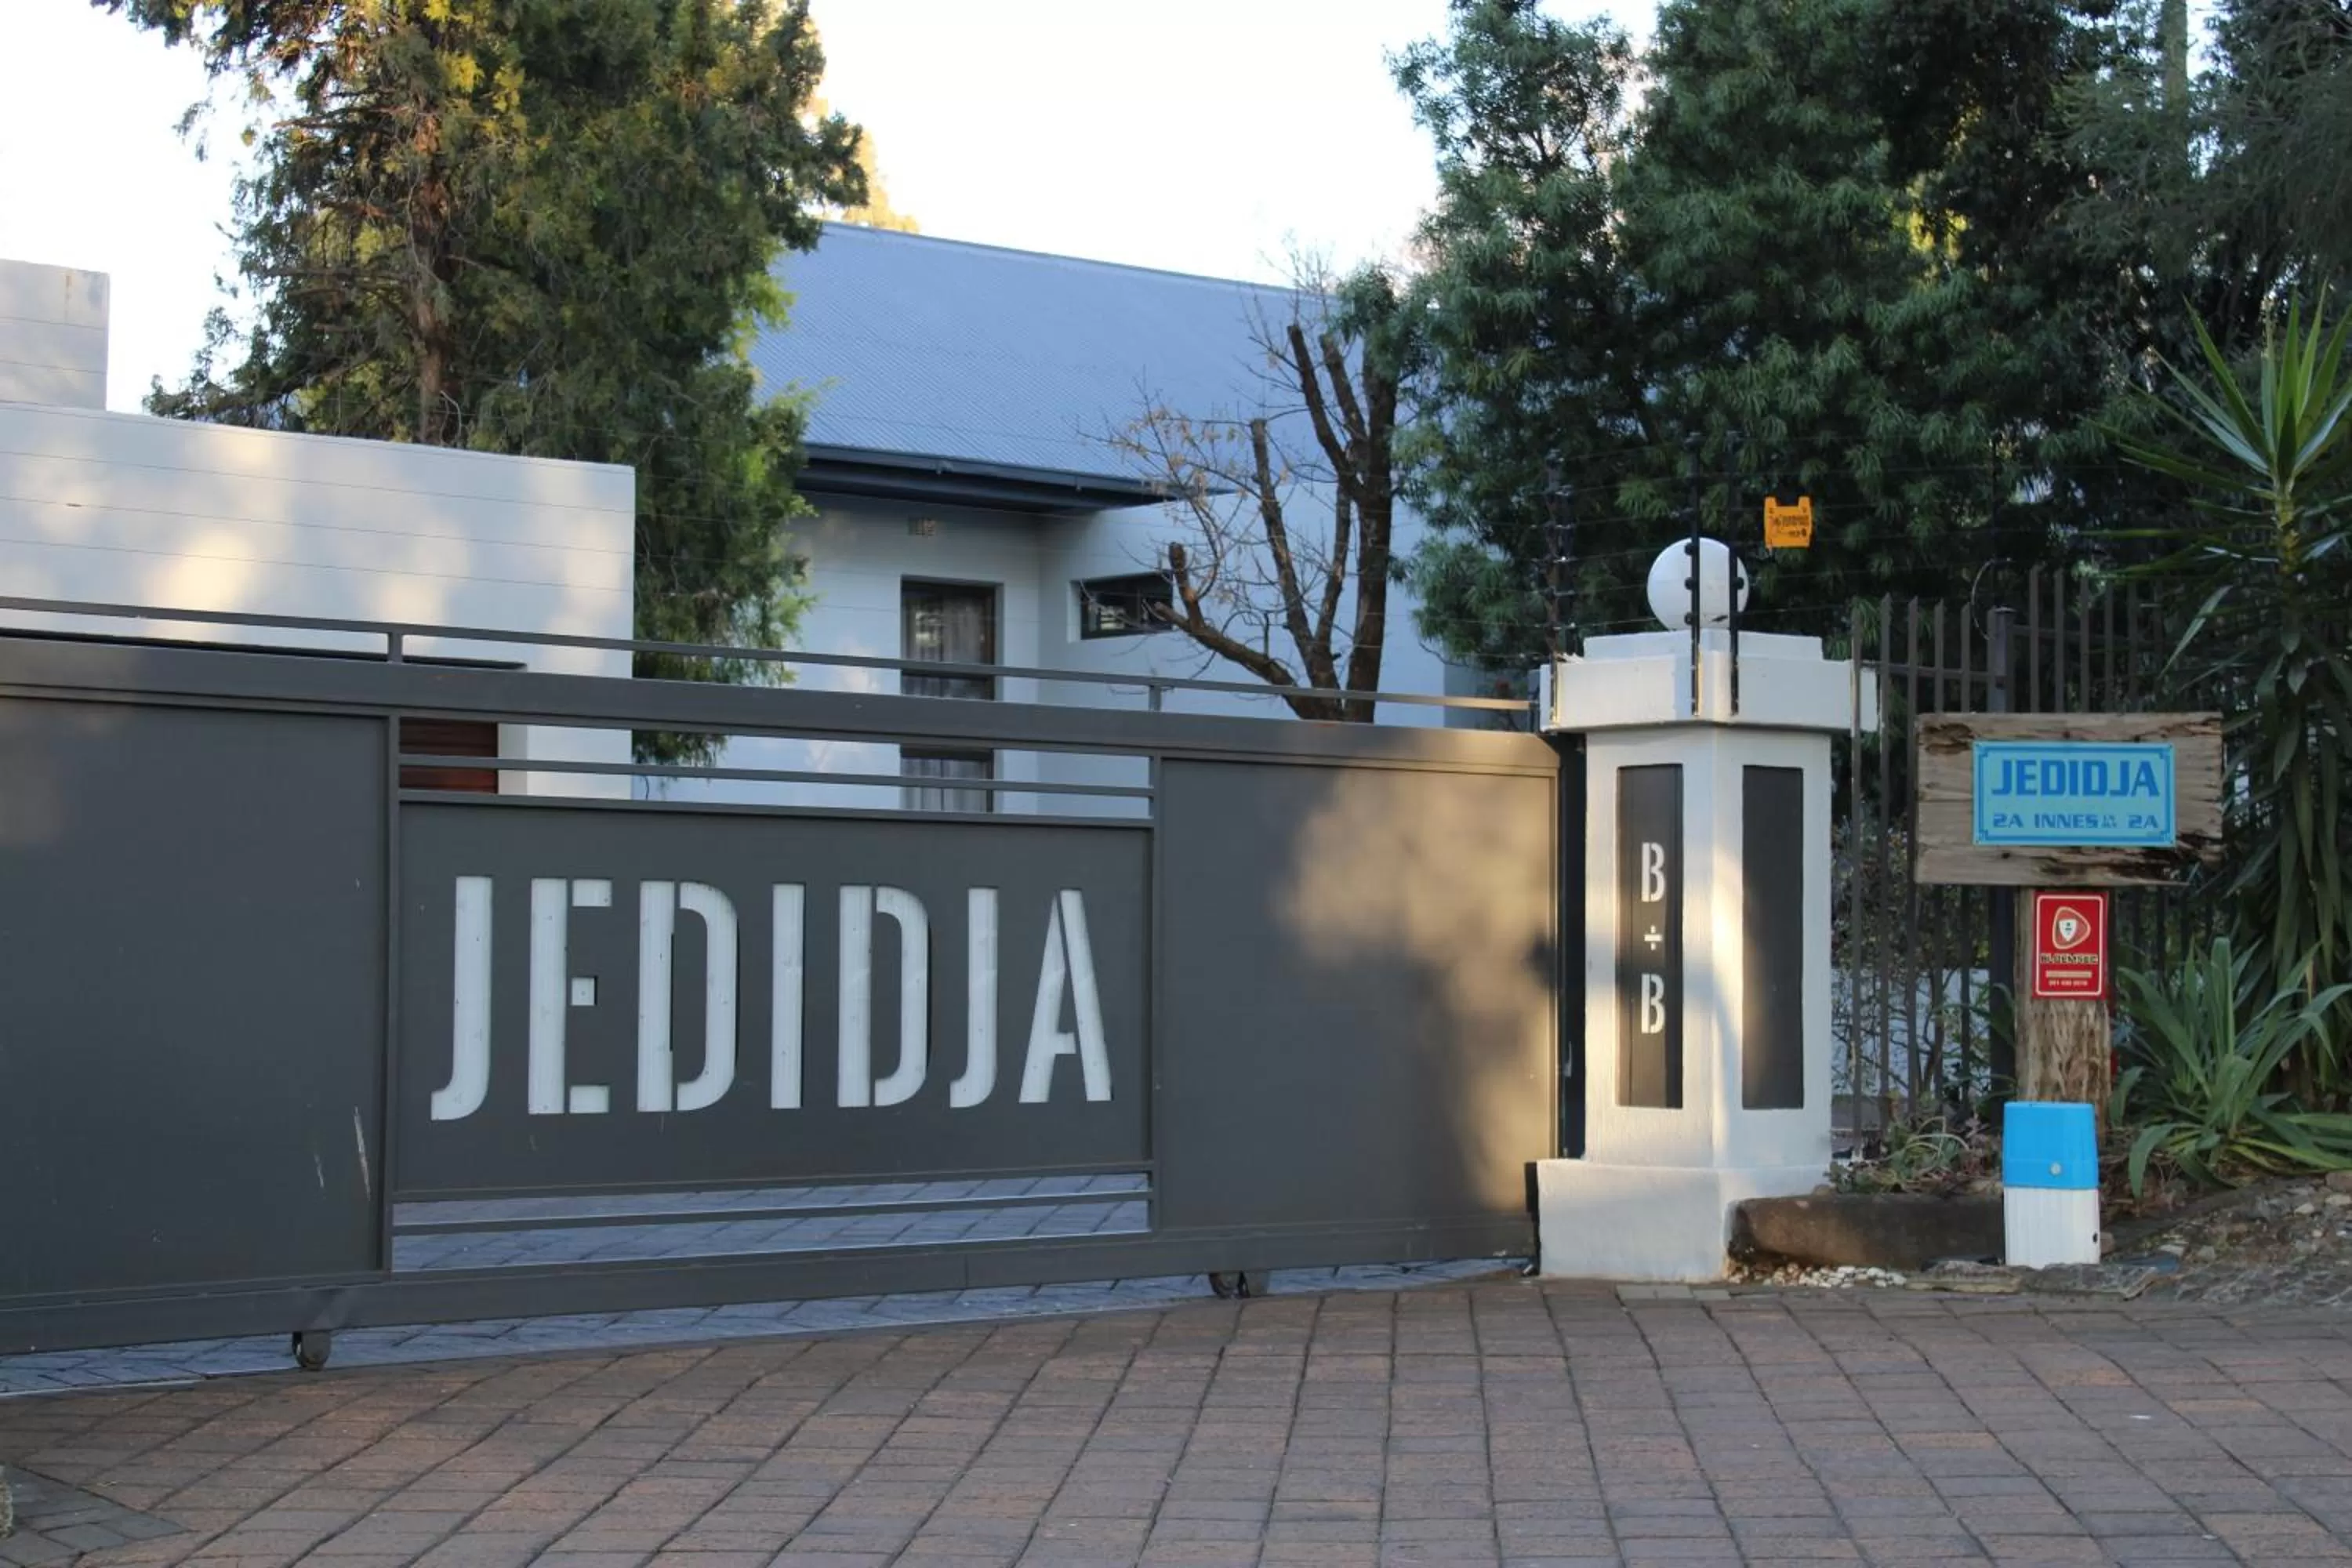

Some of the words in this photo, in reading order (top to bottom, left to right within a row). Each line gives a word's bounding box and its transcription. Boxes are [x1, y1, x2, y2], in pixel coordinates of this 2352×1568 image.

[1991, 759, 2160, 797] JEDIDJA
[1993, 813, 2024, 829] 2A
[2034, 813, 2099, 829] INNES
[2129, 814, 2159, 829] 2A
[430, 875, 1112, 1121] JEDIDJA
